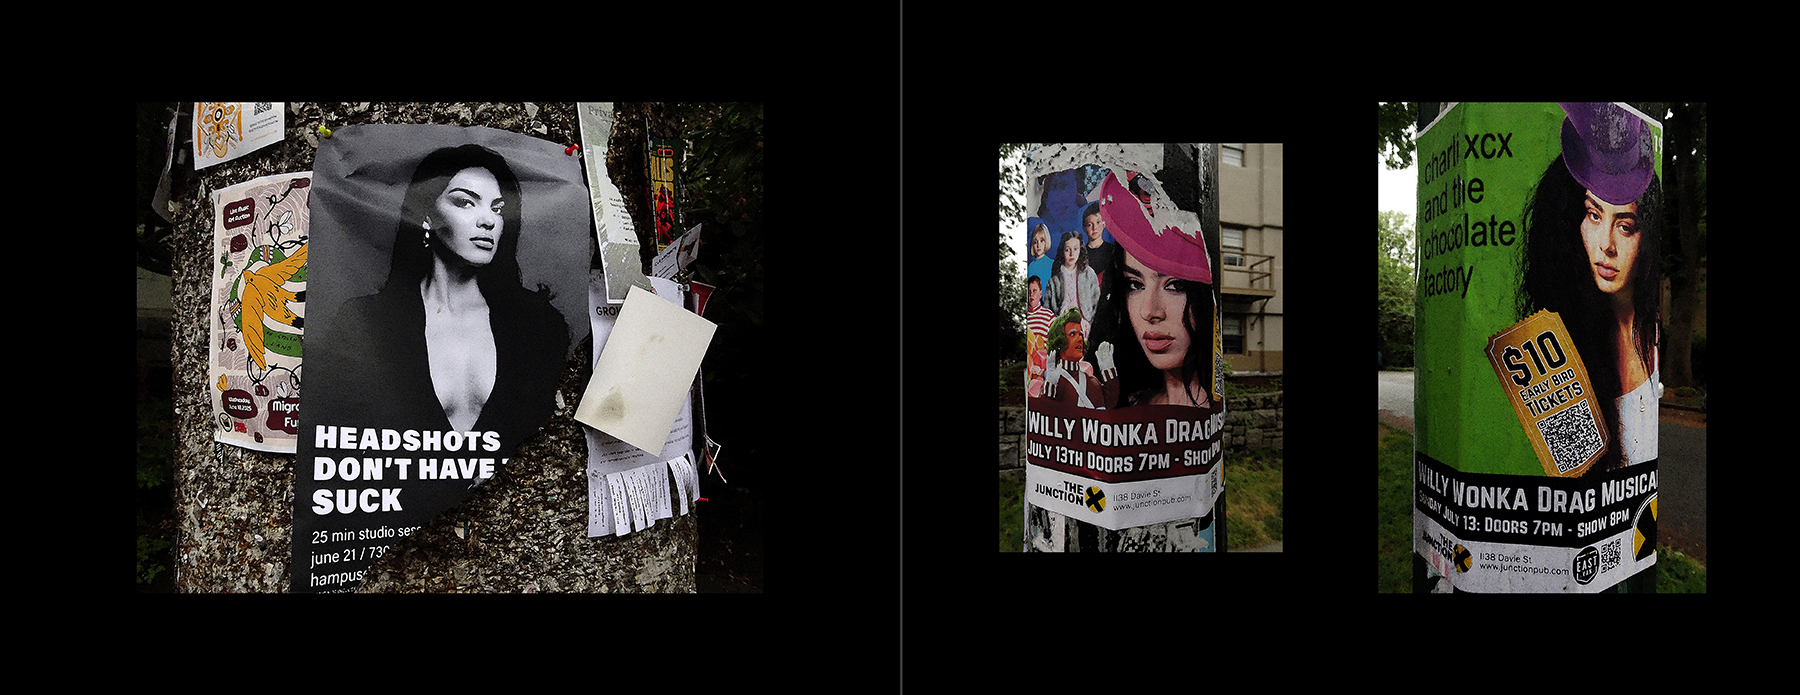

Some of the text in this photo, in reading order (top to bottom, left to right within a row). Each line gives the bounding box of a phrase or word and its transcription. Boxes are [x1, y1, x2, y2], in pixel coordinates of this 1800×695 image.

[1424, 132, 1513, 185] charli xcx
[1424, 174, 1485, 223] and the
[1424, 213, 1516, 260] chocolate
[1424, 265, 1474, 299] factory
[1502, 330, 1567, 389] $10
[1519, 368, 1576, 402] EARLY BIRD
[1524, 381, 1584, 417] TICKETS
[315, 425, 501, 452] HEADSHOTS
[1028, 411, 1076, 440] WILLY
[1082, 418, 1158, 447] WONKA
[1165, 418, 1211, 444] DRAG
[313, 456, 495, 481] DON'T HAVE
[1027, 440, 1052, 460] JULY
[1055, 446, 1083, 468] 13TH
[1087, 451, 1134, 474] DOORS
[1138, 453, 1171, 472] 7PM
[1035, 483, 1084, 507] JUNCTION
[1063, 480, 1084, 496] THE
[1130, 490, 1151, 500] Davie
[1153, 489, 1161, 498] St
[1418, 460, 1449, 497] WILLY
[1452, 478, 1529, 511] WONKA
[1537, 486, 1596, 514] DRAG
[311, 488, 403, 516] SUCK
[1113, 495, 1192, 511] www.junctionpub.com
[312, 530, 328, 545] 25
[332, 528, 355, 543] min
[358, 525, 395, 541] studio
[1442, 506, 1460, 527] JULY
[1463, 515, 1480, 532] 13:
[1484, 516, 1529, 535] DOORS
[1533, 520, 1563, 537] 7PM
[1577, 515, 1607, 538] SHOW
[1609, 508, 1630, 527] 8PM
[1440, 532, 1453, 552] THE
[310, 551, 340, 569] june
[343, 548, 356, 562] 21
[359, 547, 366, 561] /
[1479, 562, 1570, 576] www.junctionpub.com
[1498, 554, 1521, 563] Davie
[1523, 555, 1532, 564] St
[1576, 555, 1598, 573] EAST
